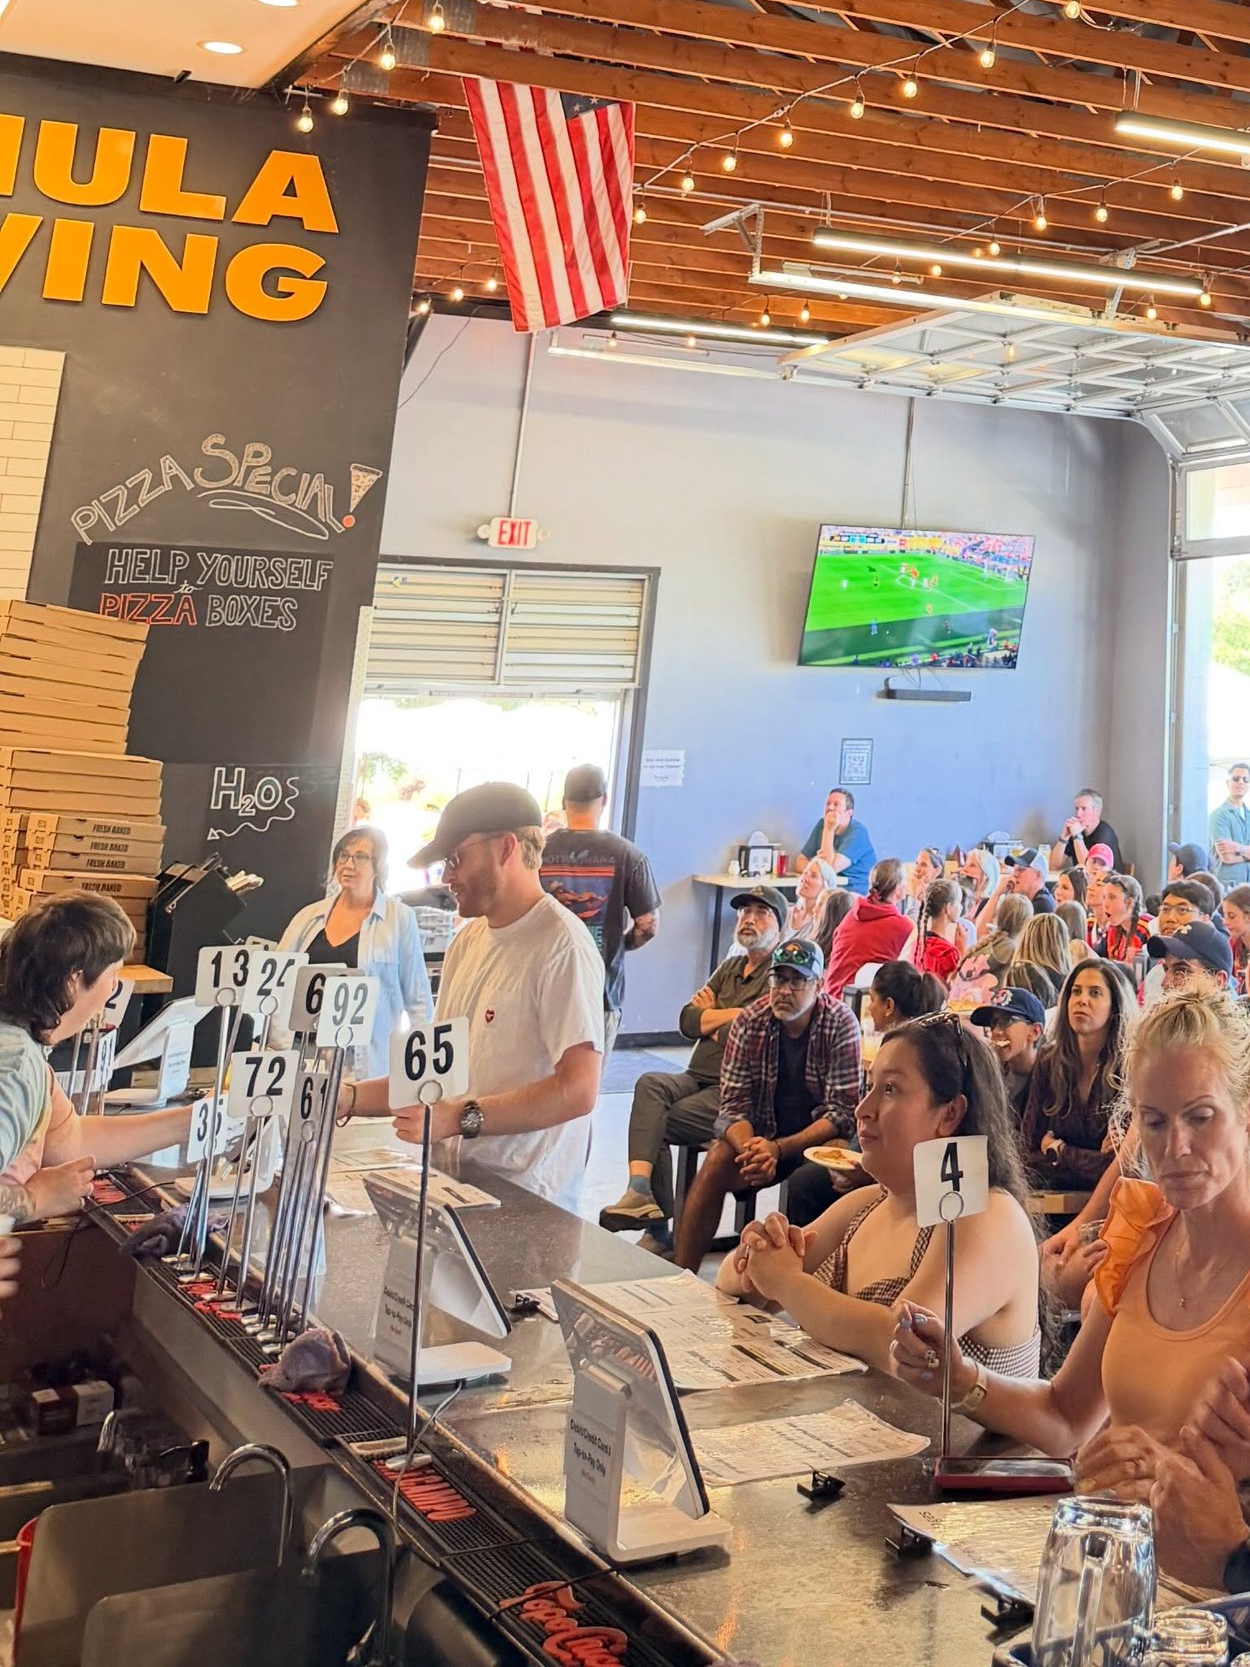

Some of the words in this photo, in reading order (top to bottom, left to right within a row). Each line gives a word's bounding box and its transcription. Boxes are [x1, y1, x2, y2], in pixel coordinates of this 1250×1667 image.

[70, 454, 194, 546] PIZZA
[498, 519, 532, 546] EXIT
[104, 548, 190, 585] HELP
[196, 552, 334, 591] YOURSELF
[100, 593, 198, 626] PIZZA
[205, 595, 299, 632] BOXES
[210, 948, 250, 988] 13
[331, 982, 369, 1026] 92
[404, 1023, 455, 1082] 65
[245, 1056, 287, 1098] 72
[941, 1141, 964, 1192] 4
